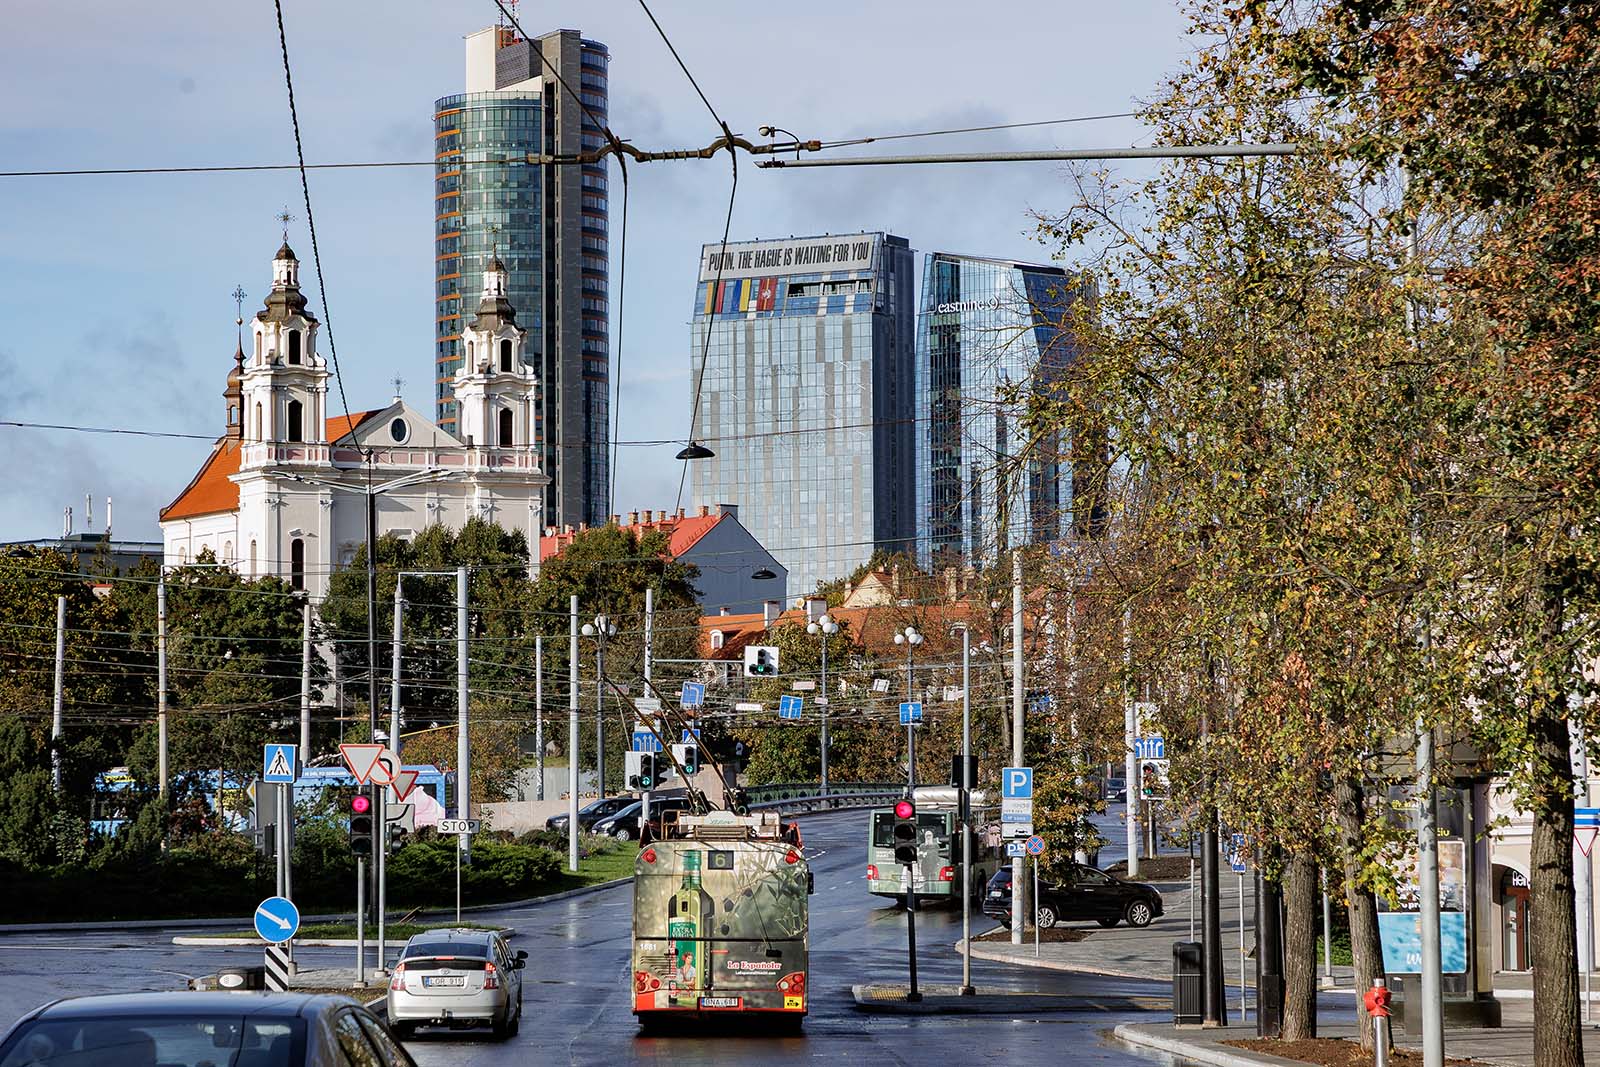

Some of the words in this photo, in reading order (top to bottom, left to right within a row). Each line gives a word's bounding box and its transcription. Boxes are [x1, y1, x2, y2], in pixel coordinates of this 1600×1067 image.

[708, 252, 735, 271] PUTIN,
[738, 251, 753, 269] THE
[754, 248, 783, 268] HAGUE
[783, 247, 793, 266] IS
[794, 244, 831, 265] WAITING
[832, 243, 849, 262] FOR
[852, 242, 870, 260] YOU
[938, 300, 985, 313] eastnine
[1010, 771, 1027, 795] P
[442, 821, 475, 831] STOP
[715, 853, 726, 867] 6
[727, 960, 739, 969] La
